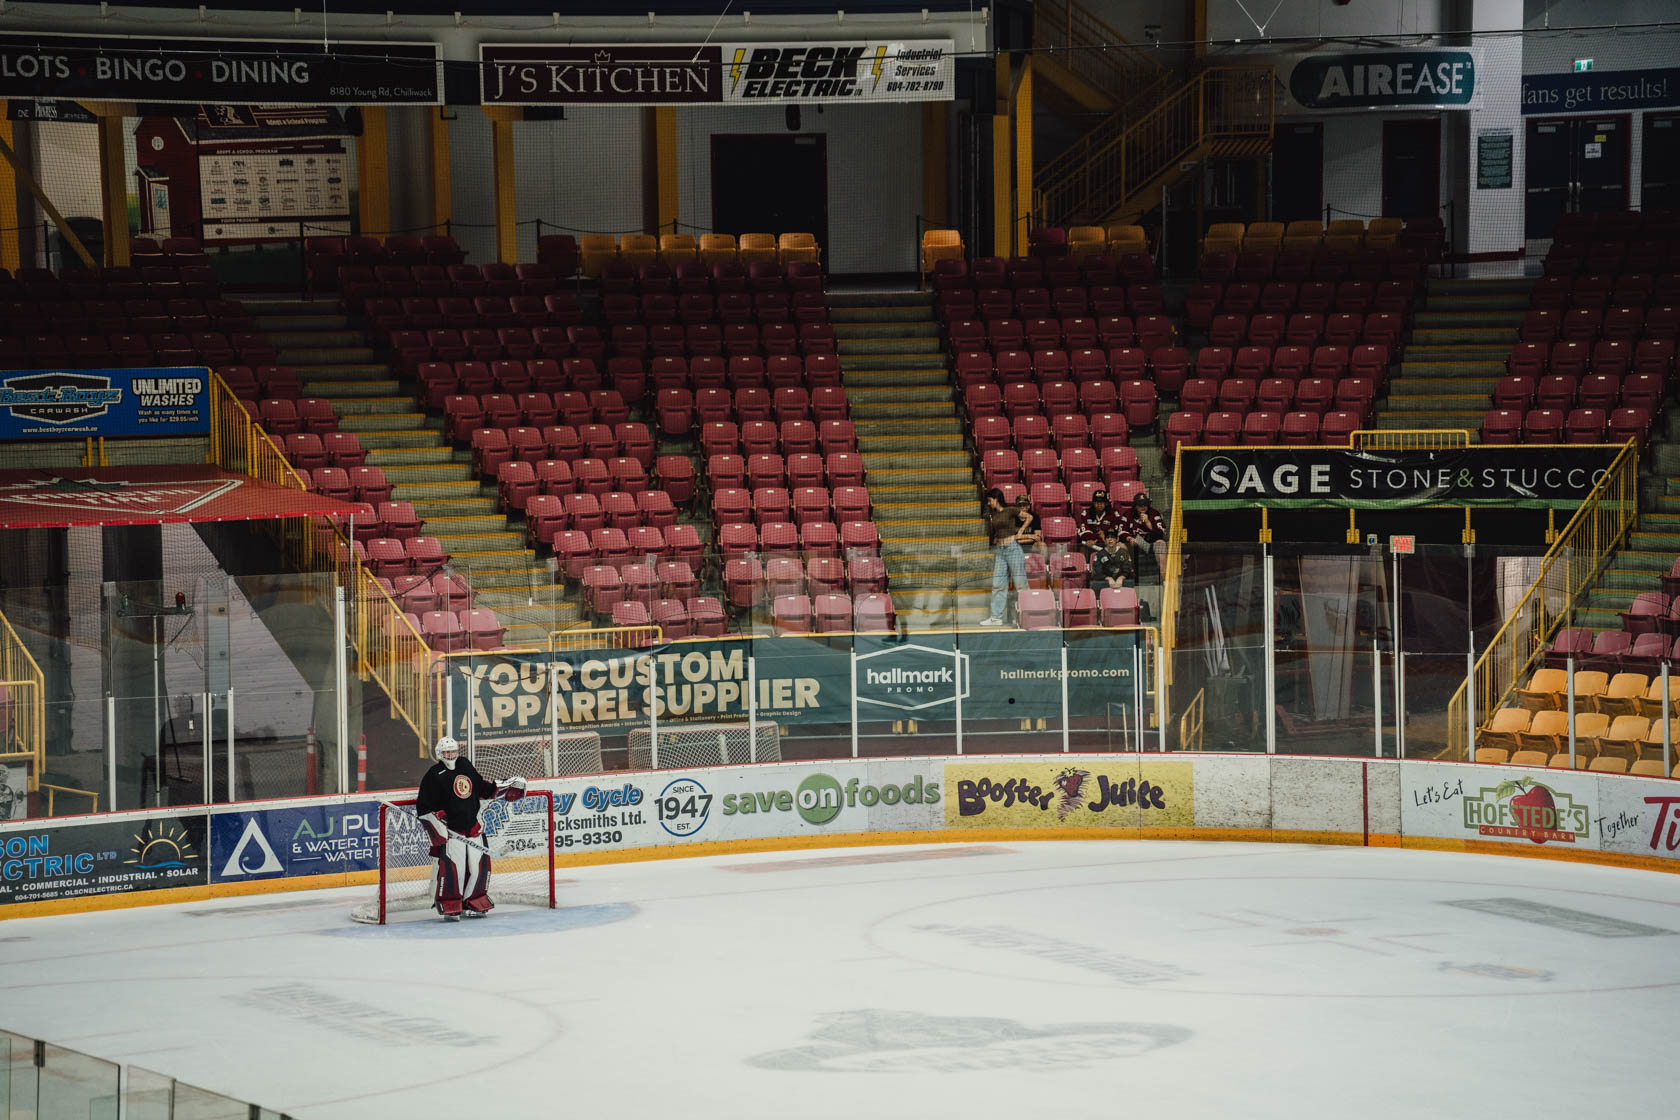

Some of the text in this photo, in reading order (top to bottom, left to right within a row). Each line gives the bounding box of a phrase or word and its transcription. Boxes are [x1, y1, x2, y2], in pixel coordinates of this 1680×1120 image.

[744, 46, 869, 80] BECK
[896, 48, 943, 61] Industrial
[1, 54, 310, 84] LOTS BINGO DINING
[895, 65, 936, 77] Services
[1318, 62, 1465, 98] AIREASE
[329, 87, 351, 96] 8180
[353, 87, 377, 99] Young
[394, 88, 432, 98] Chilliwack
[494, 64, 711, 99] J'S KITCHEN
[742, 79, 857, 98] ELECTRIC
[1521, 77, 1668, 109] fans get results!
[132, 378, 202, 395] UNLIMITED
[140, 394, 194, 407] WASHES
[1209, 463, 1332, 495] SAGE
[458, 649, 744, 697] YOUR CUSTOM
[866, 667, 953, 685] hallmark
[460, 677, 821, 730] APPAREL SUPPLIER
[582, 782, 645, 813] Cycle
[672, 784, 695, 794] SINCE
[957, 774, 1166, 816] Booster Juice
[1414, 778, 1464, 807] Let's Eat
[621, 810, 647, 827] Ltd.
[654, 794, 713, 821] 1947
[1469, 801, 1585, 832] HOFSTEDE'S
[292, 816, 334, 840] AJ
[676, 822, 691, 832] EST.
[1480, 827, 1575, 841] COUNTRY BARN
[1594, 812, 1640, 839] Together
[0, 834, 49, 858] ON
[292, 843, 303, 854] &
[305, 838, 358, 853] WATER
[325, 848, 374, 863] WATER
[392, 845, 419, 856] LIFE
[0, 851, 118, 881] CTRIC LTD
[22, 878, 89, 891] COMMERCIAL
[98, 870, 158, 884] INDUSTRIAL
[166, 867, 199, 878] SOLAR
[64, 884, 134, 896] OLSONELECTRIC.CA
